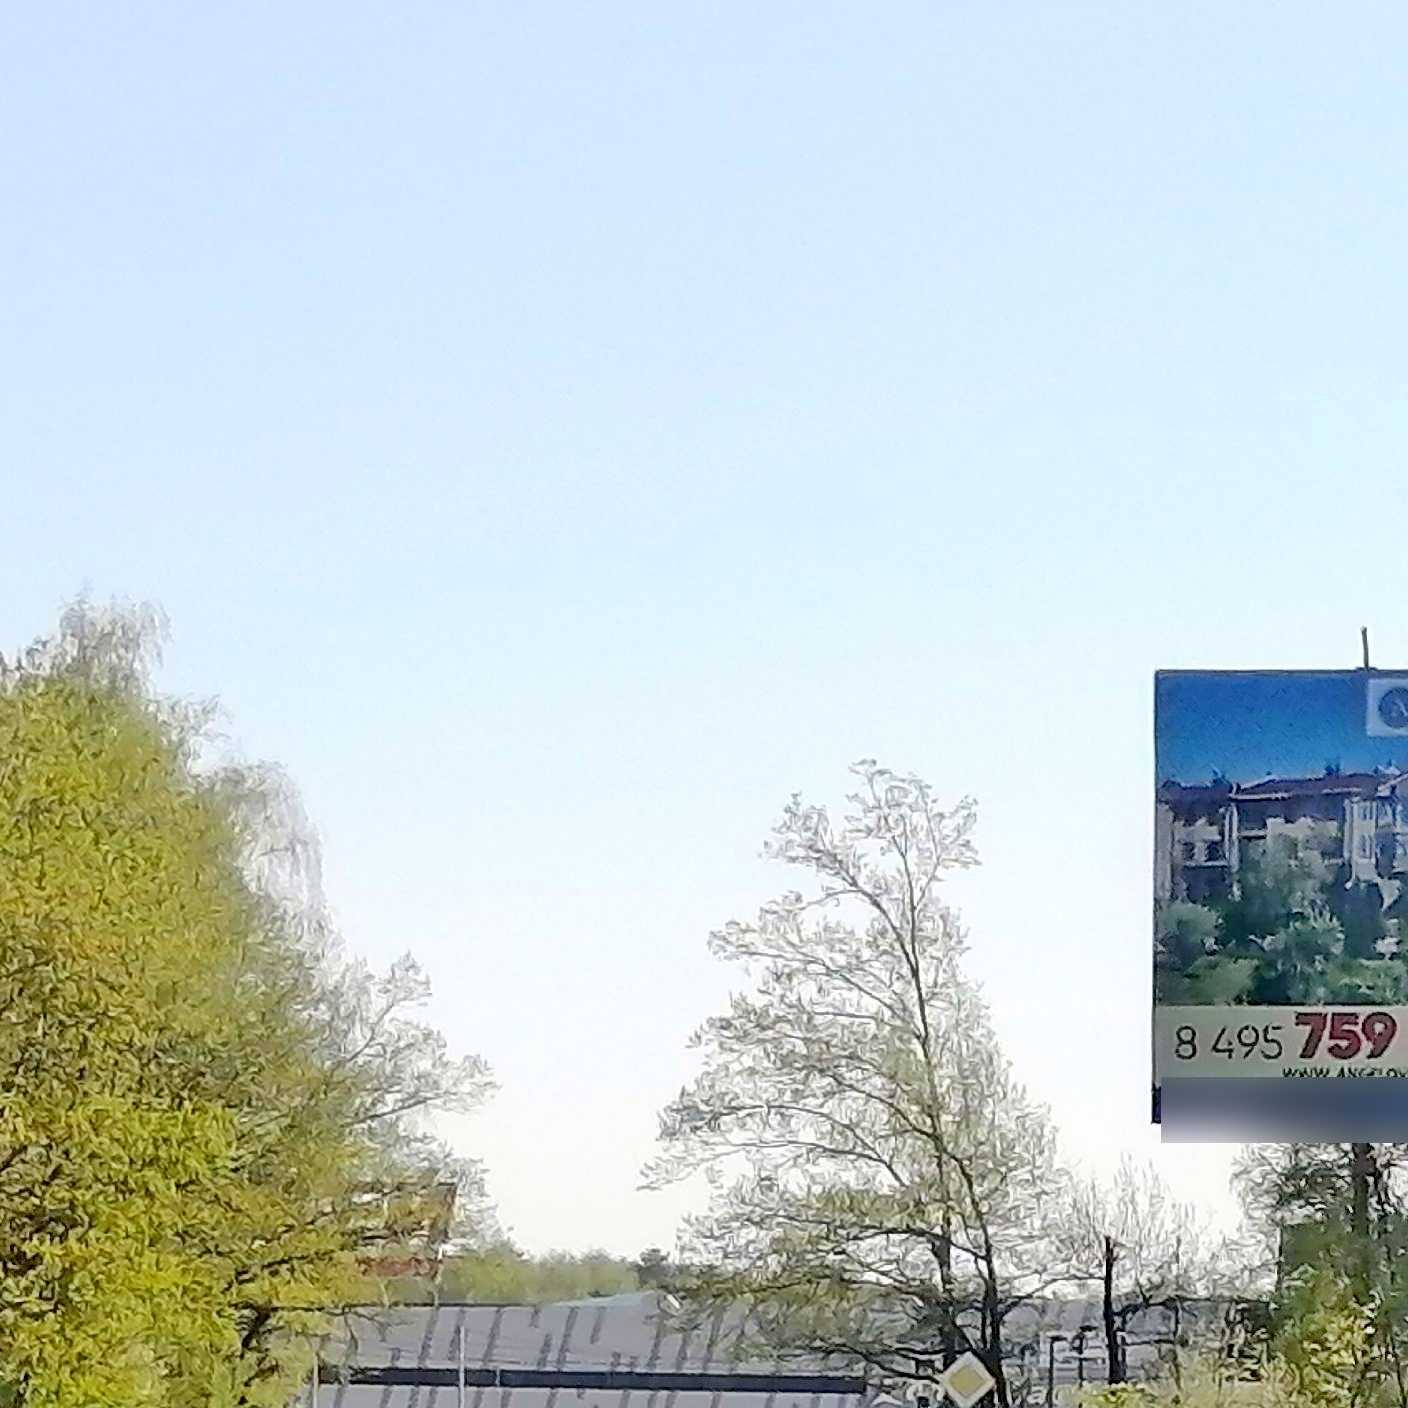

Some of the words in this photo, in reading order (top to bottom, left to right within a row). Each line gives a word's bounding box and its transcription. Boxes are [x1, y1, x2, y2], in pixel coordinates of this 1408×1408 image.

[1174, 1025, 1197, 1060] 8
[1211, 1023, 1283, 1060] 495
[1294, 1011, 1397, 1060] 759
